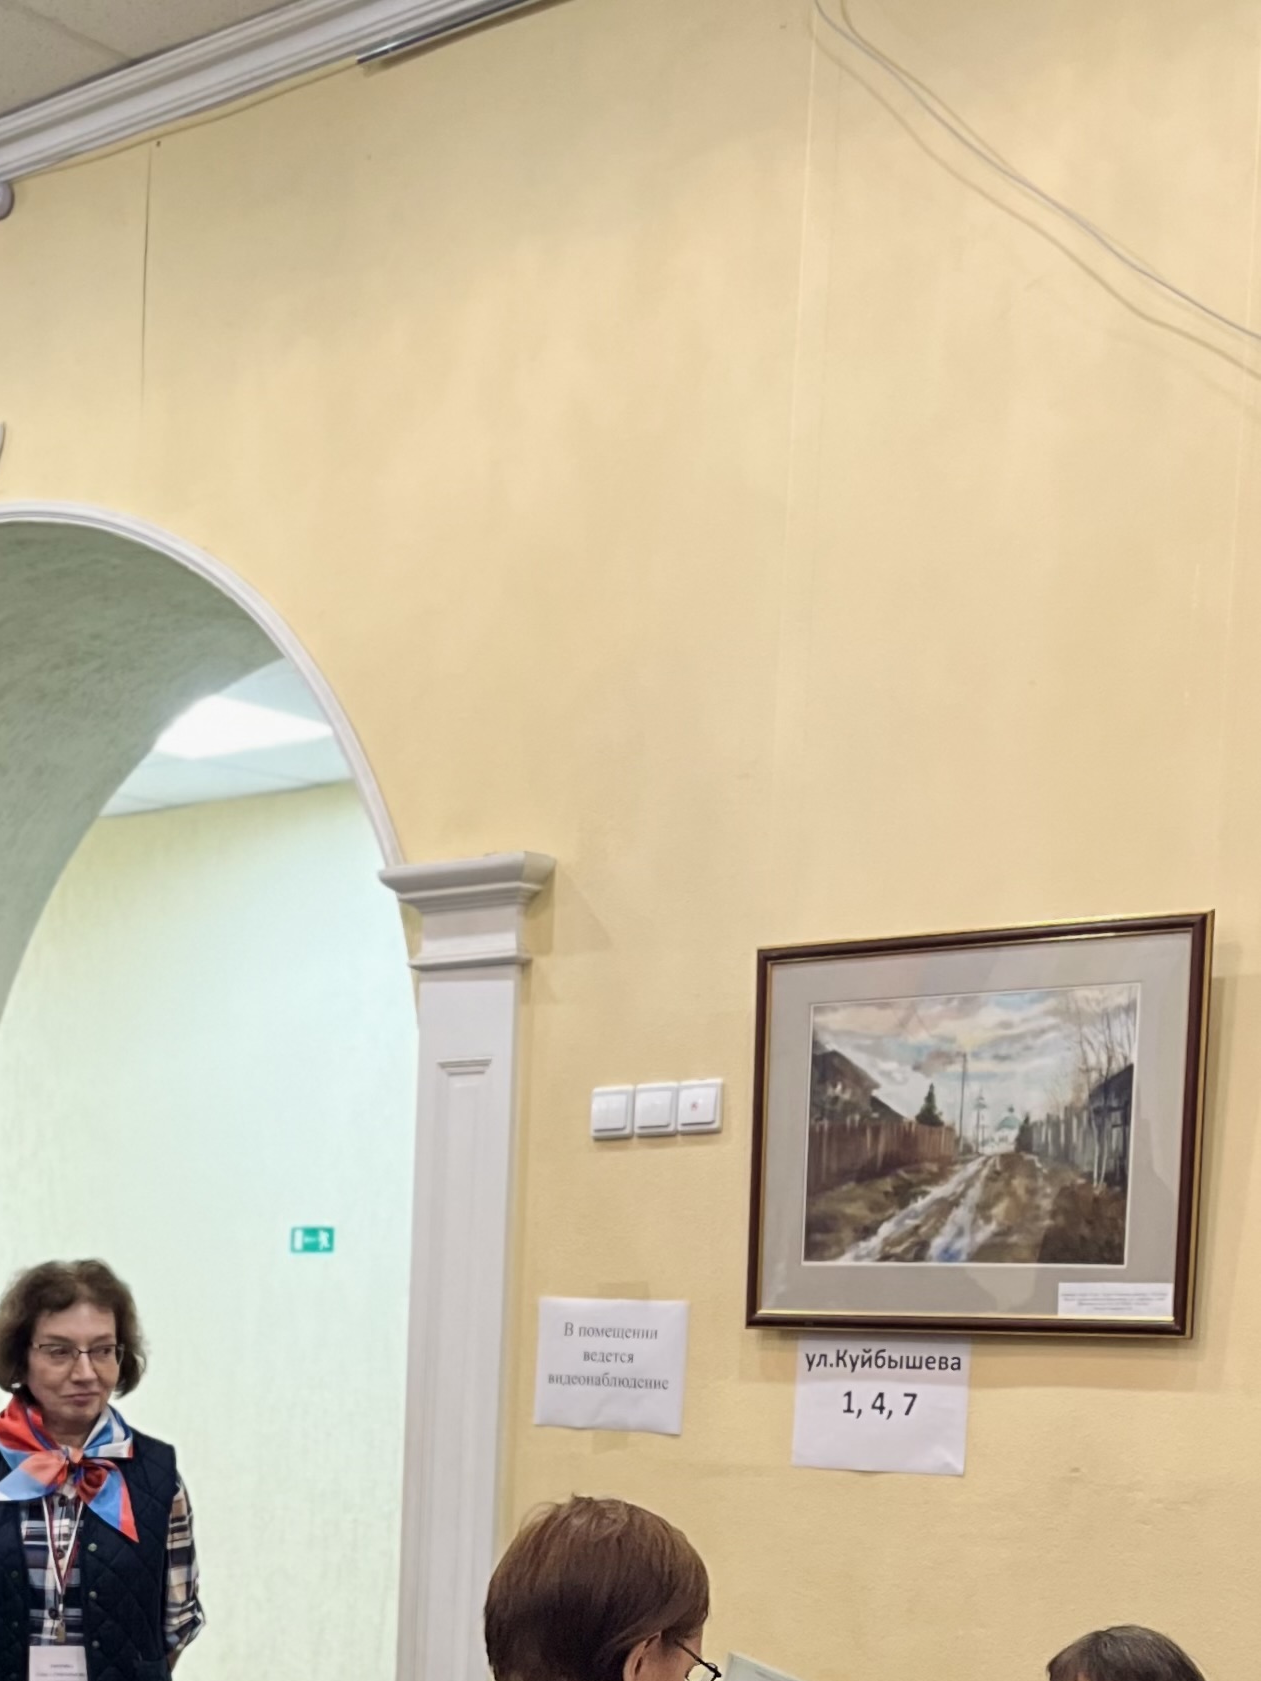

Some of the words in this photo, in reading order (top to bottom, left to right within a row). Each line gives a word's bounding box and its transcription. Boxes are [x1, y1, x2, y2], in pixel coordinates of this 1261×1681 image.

[564, 1321, 575, 1338] В
[578, 1325, 659, 1341] помещении
[583, 1350, 635, 1364] ведется
[805, 1348, 962, 1373] ул.Куйбышева
[547, 1372, 670, 1391] видеонаблюдение
[842, 1390, 863, 1419] 1,
[870, 1391, 893, 1420] 4,
[903, 1392, 918, 1416] 7
